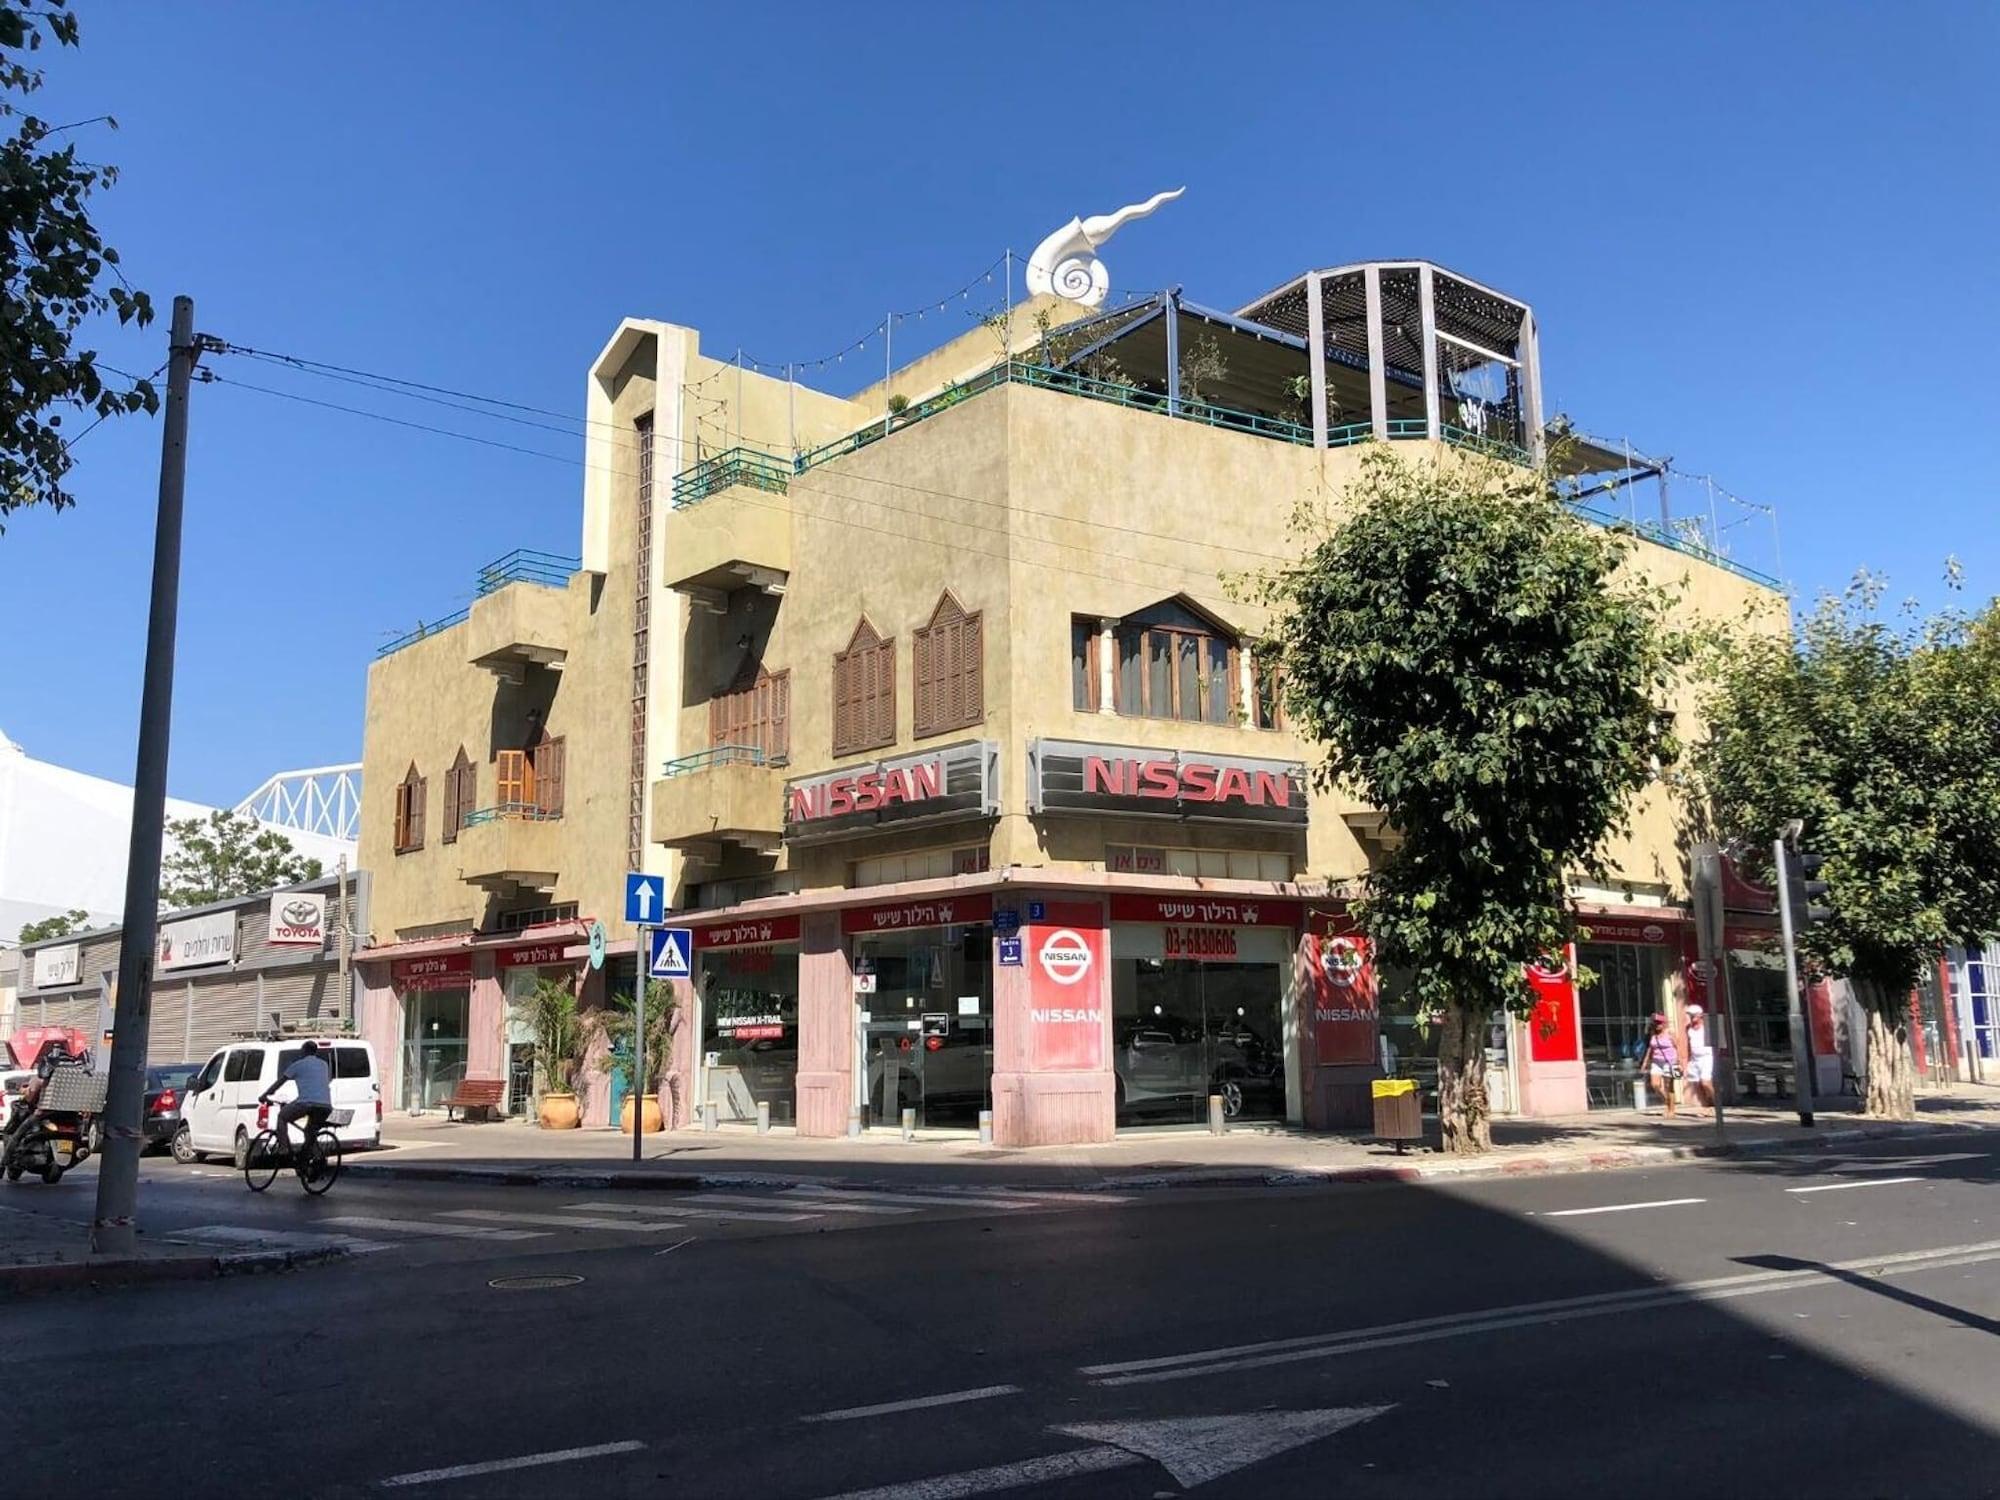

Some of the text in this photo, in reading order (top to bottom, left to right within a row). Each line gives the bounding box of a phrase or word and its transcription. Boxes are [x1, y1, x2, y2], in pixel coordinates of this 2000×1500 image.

[1084, 756, 1289, 807] NISSAN
[791, 761, 941, 822] NISSAN
[873, 905, 935, 926] הילוך שישי
[1033, 904, 1040, 917] 3
[1159, 902, 1237, 921] הילוך שישי
[276, 927, 320, 938] TOYOTA
[732, 924, 758, 943] הילוך
[1044, 952, 1088, 961] NISSAN
[1030, 1007, 1102, 1023] NISSAN
[1315, 1009, 1375, 1021] NISSAN
